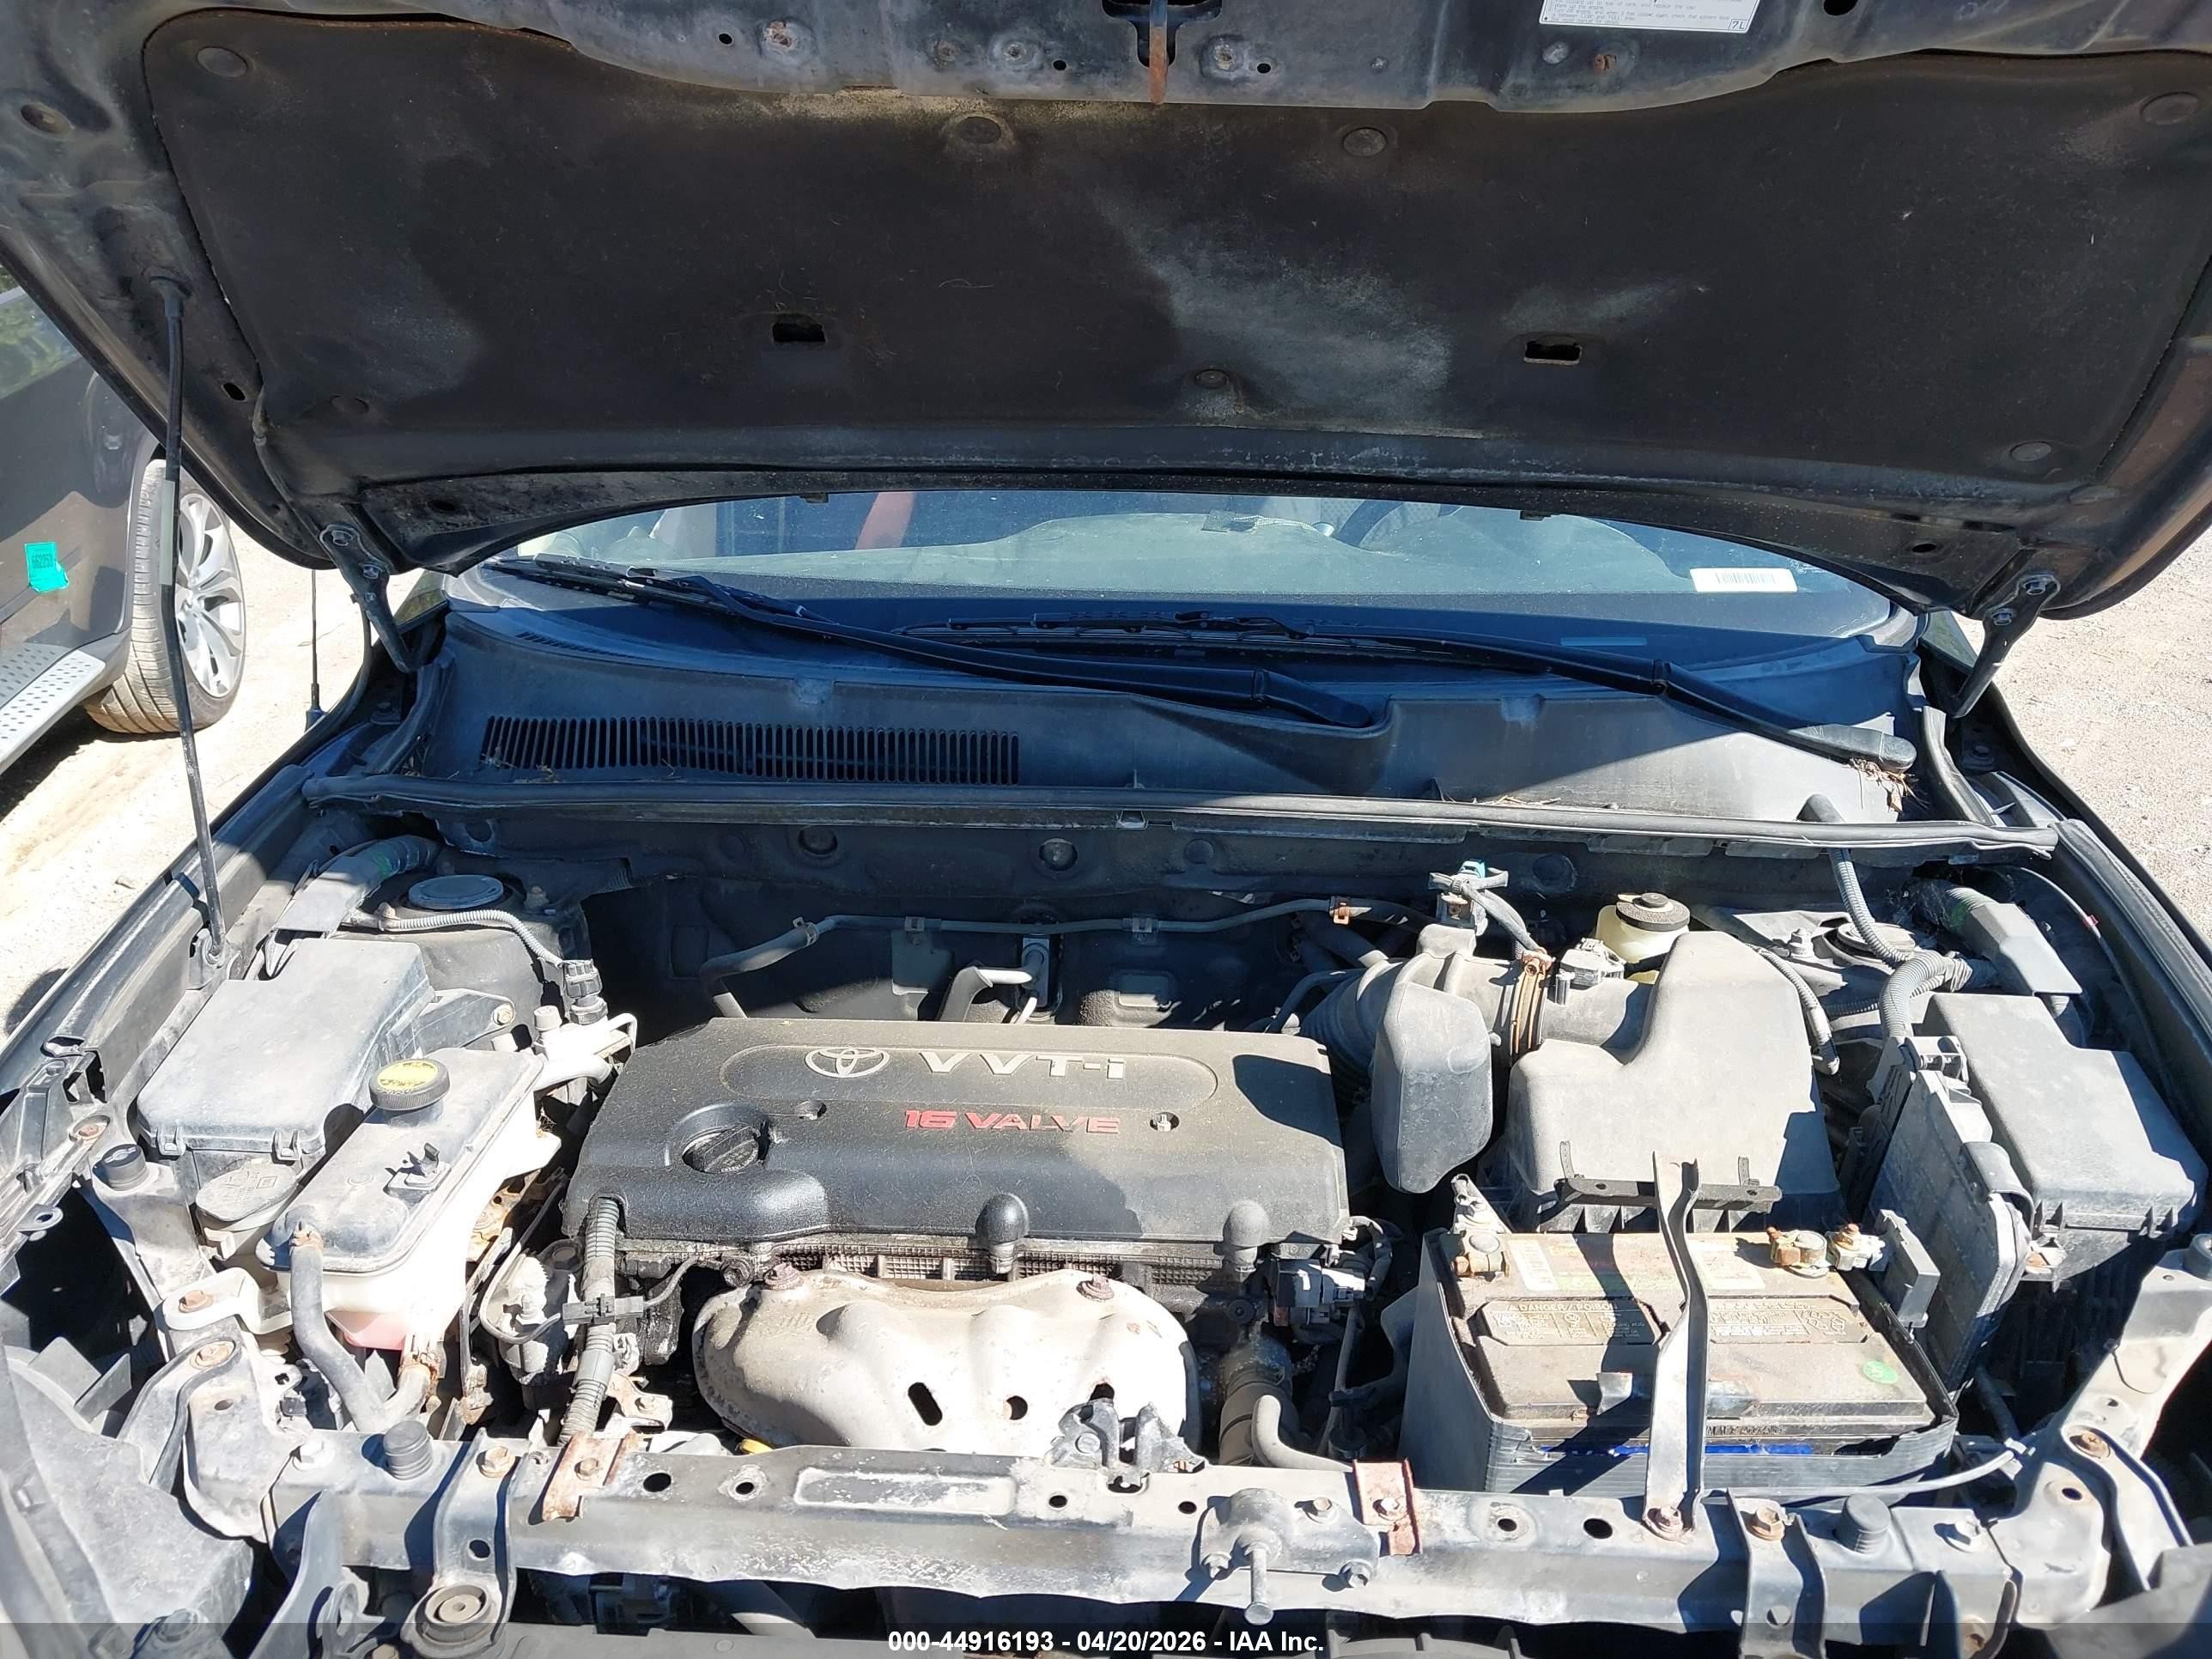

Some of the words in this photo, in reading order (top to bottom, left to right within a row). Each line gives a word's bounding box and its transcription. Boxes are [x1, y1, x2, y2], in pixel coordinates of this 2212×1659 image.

[919, 1052, 1125, 1079] VVT-i
[905, 1109, 957, 1128] 16
[965, 1112, 1121, 1133] VALVE
